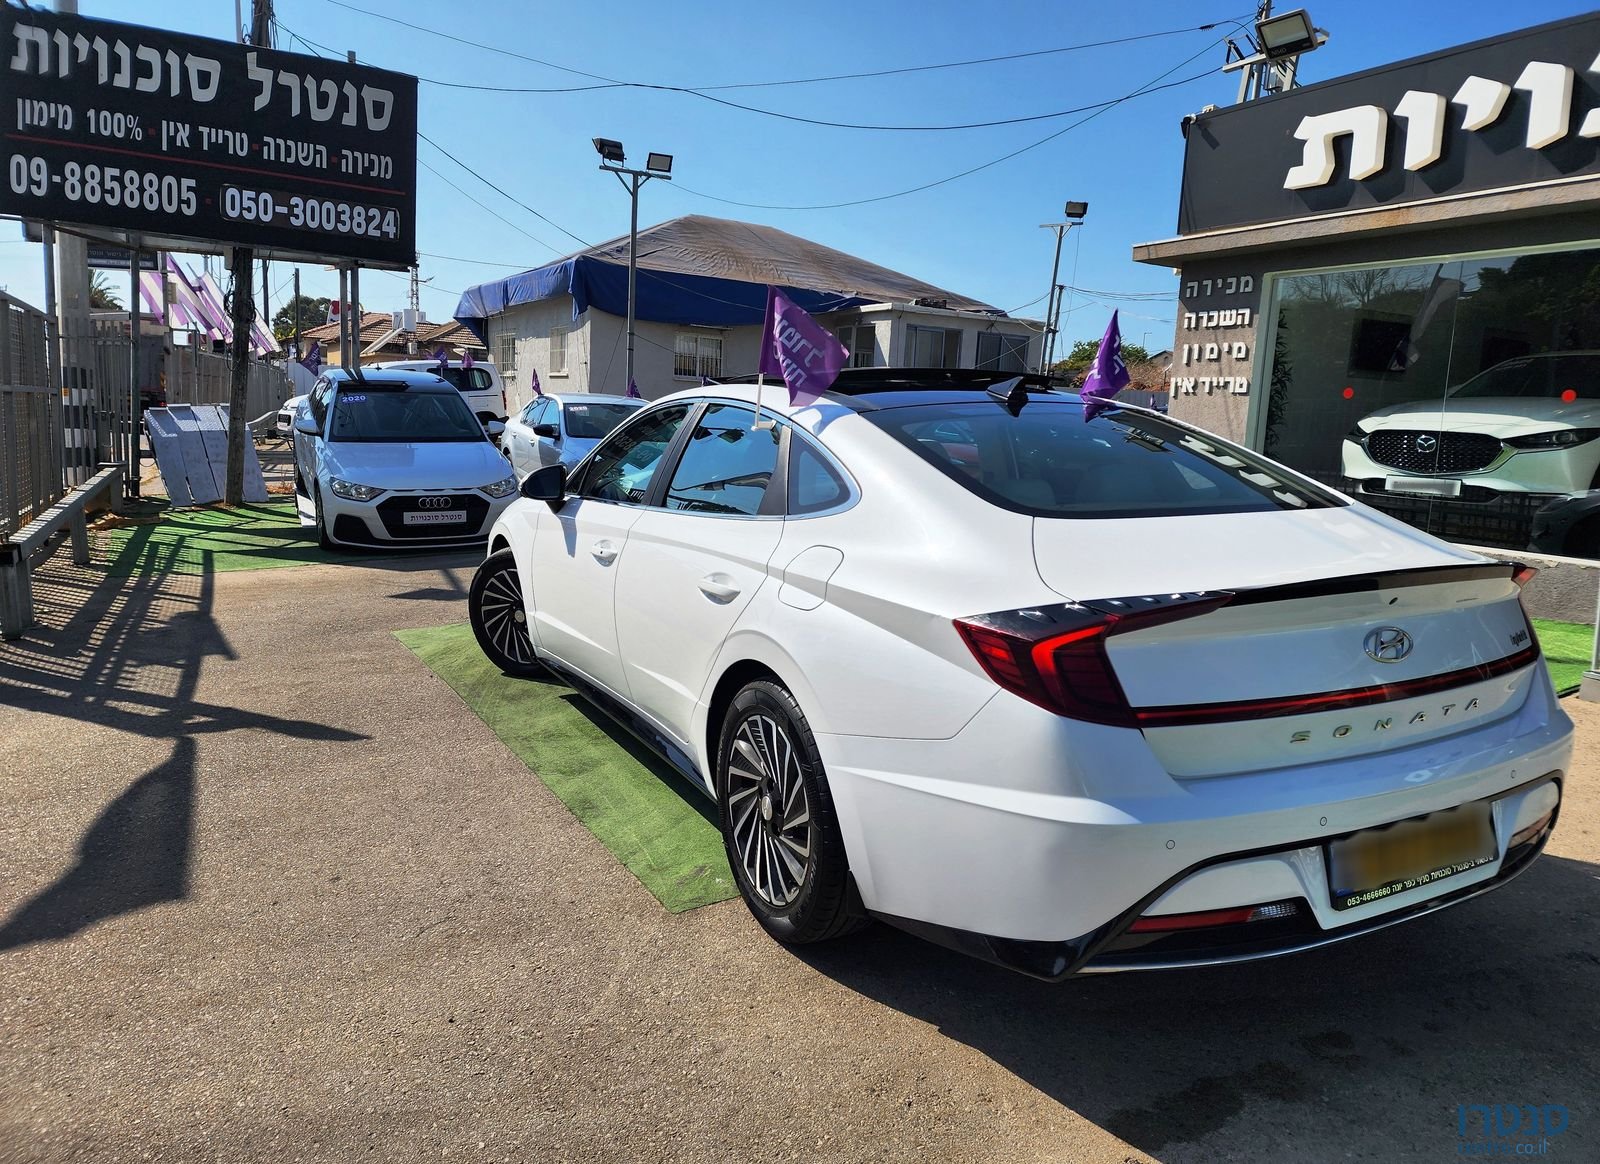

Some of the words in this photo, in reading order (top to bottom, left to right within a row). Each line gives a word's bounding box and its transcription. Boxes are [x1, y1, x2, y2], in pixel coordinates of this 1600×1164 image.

[9, 21, 222, 102] סוכנויות
[246, 51, 394, 132] סנטרל
[16, 97, 73, 131] מימון
[86, 108, 143, 141] 100%
[161, 119, 191, 151] אין
[198, 125, 249, 157] טרייד
[262, 134, 328, 169] השכרה
[341, 148, 393, 180] מכירה
[9, 153, 197, 216] 09-8858805
[224, 186, 397, 239] 050-3003824
[1186, 275, 1253, 298] מכירה
[1184, 308, 1250, 329] השכרה
[1183, 341, 1246, 364] מימון
[342, 395, 367, 403] 2020
[1170, 376, 1195, 397] אין
[1200, 376, 1248, 394] טרייד
[1290, 698, 1480, 744] SONATA
